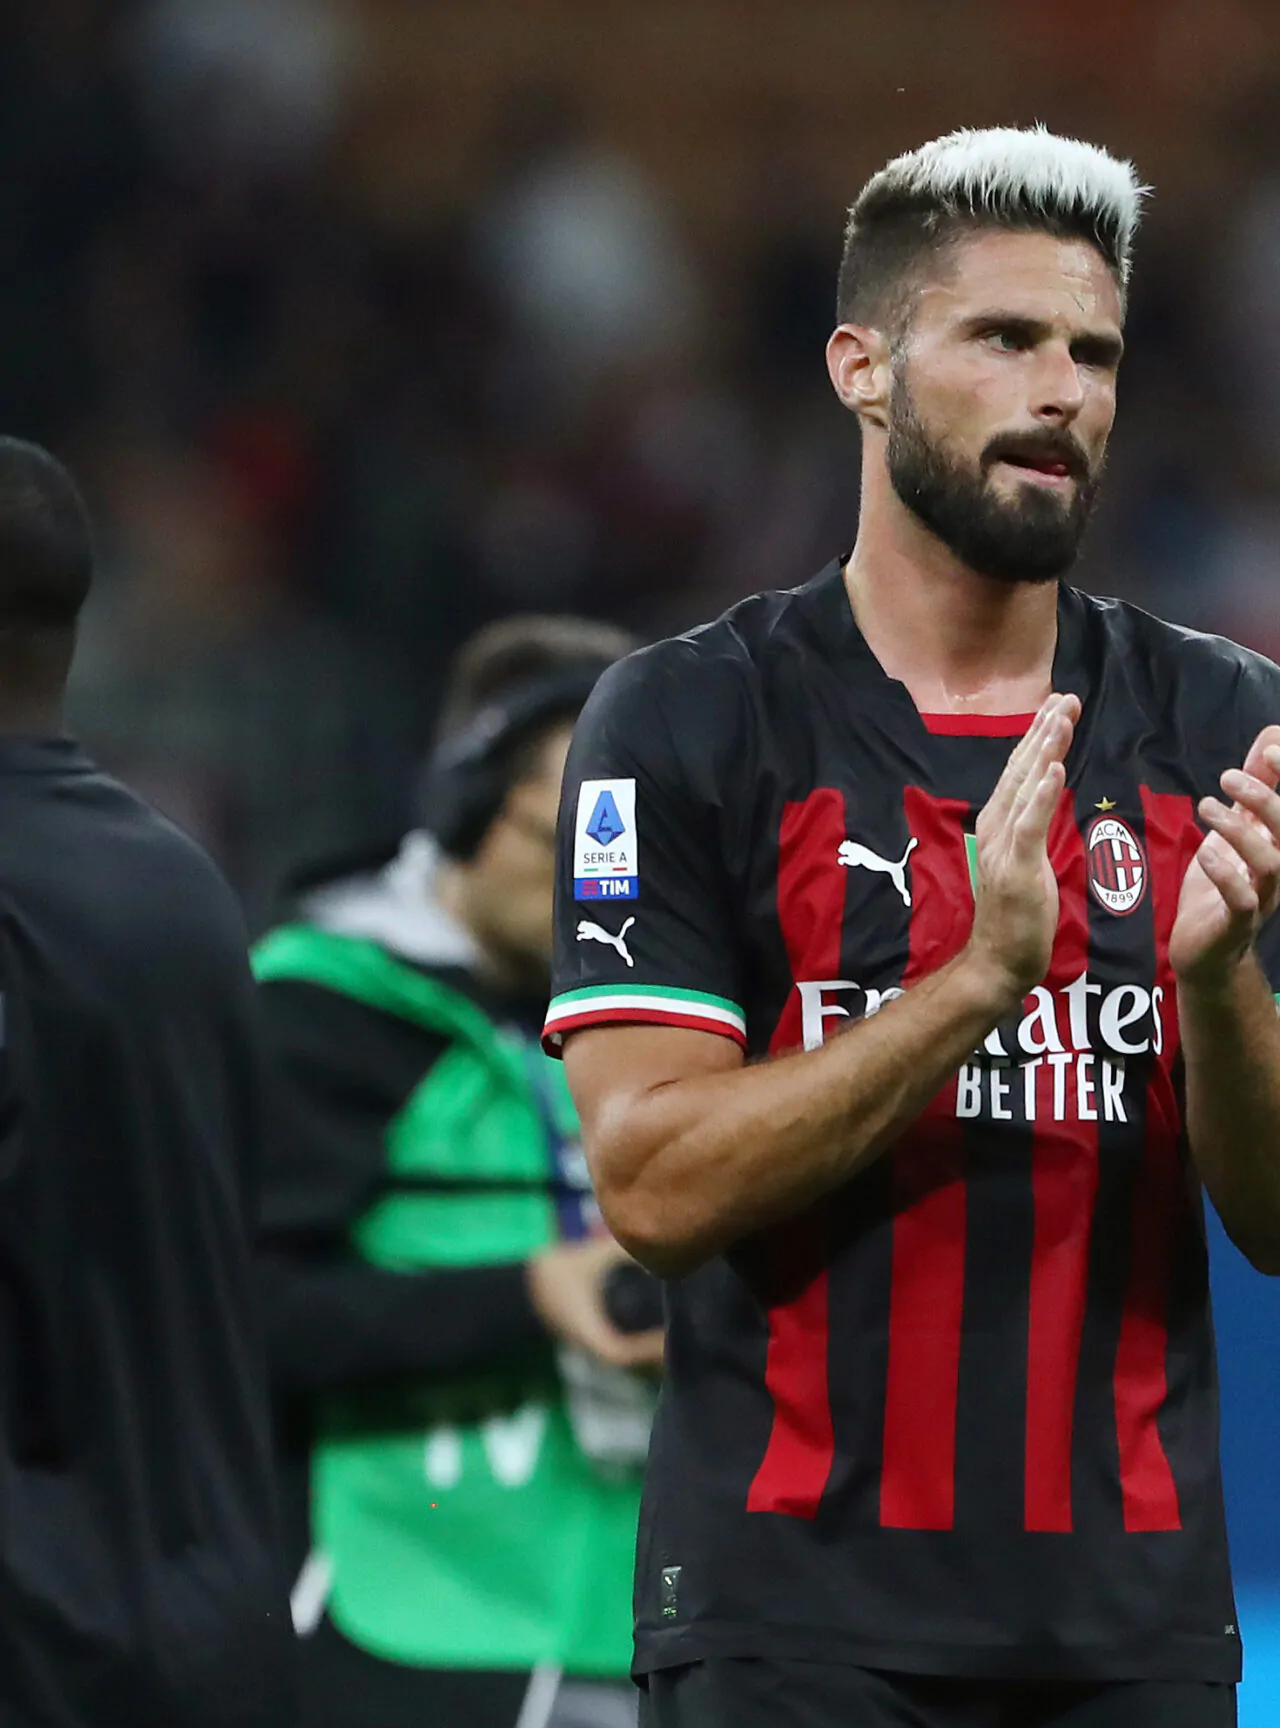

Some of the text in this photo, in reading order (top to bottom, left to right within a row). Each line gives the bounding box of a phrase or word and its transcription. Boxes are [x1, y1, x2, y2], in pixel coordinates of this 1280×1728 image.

[1094, 823, 1128, 841] ACM
[583, 851, 628, 864] SERIE A
[599, 879, 630, 896] TIM
[1105, 891, 1134, 904] 1899
[954, 1052, 1128, 1122] BETTER
